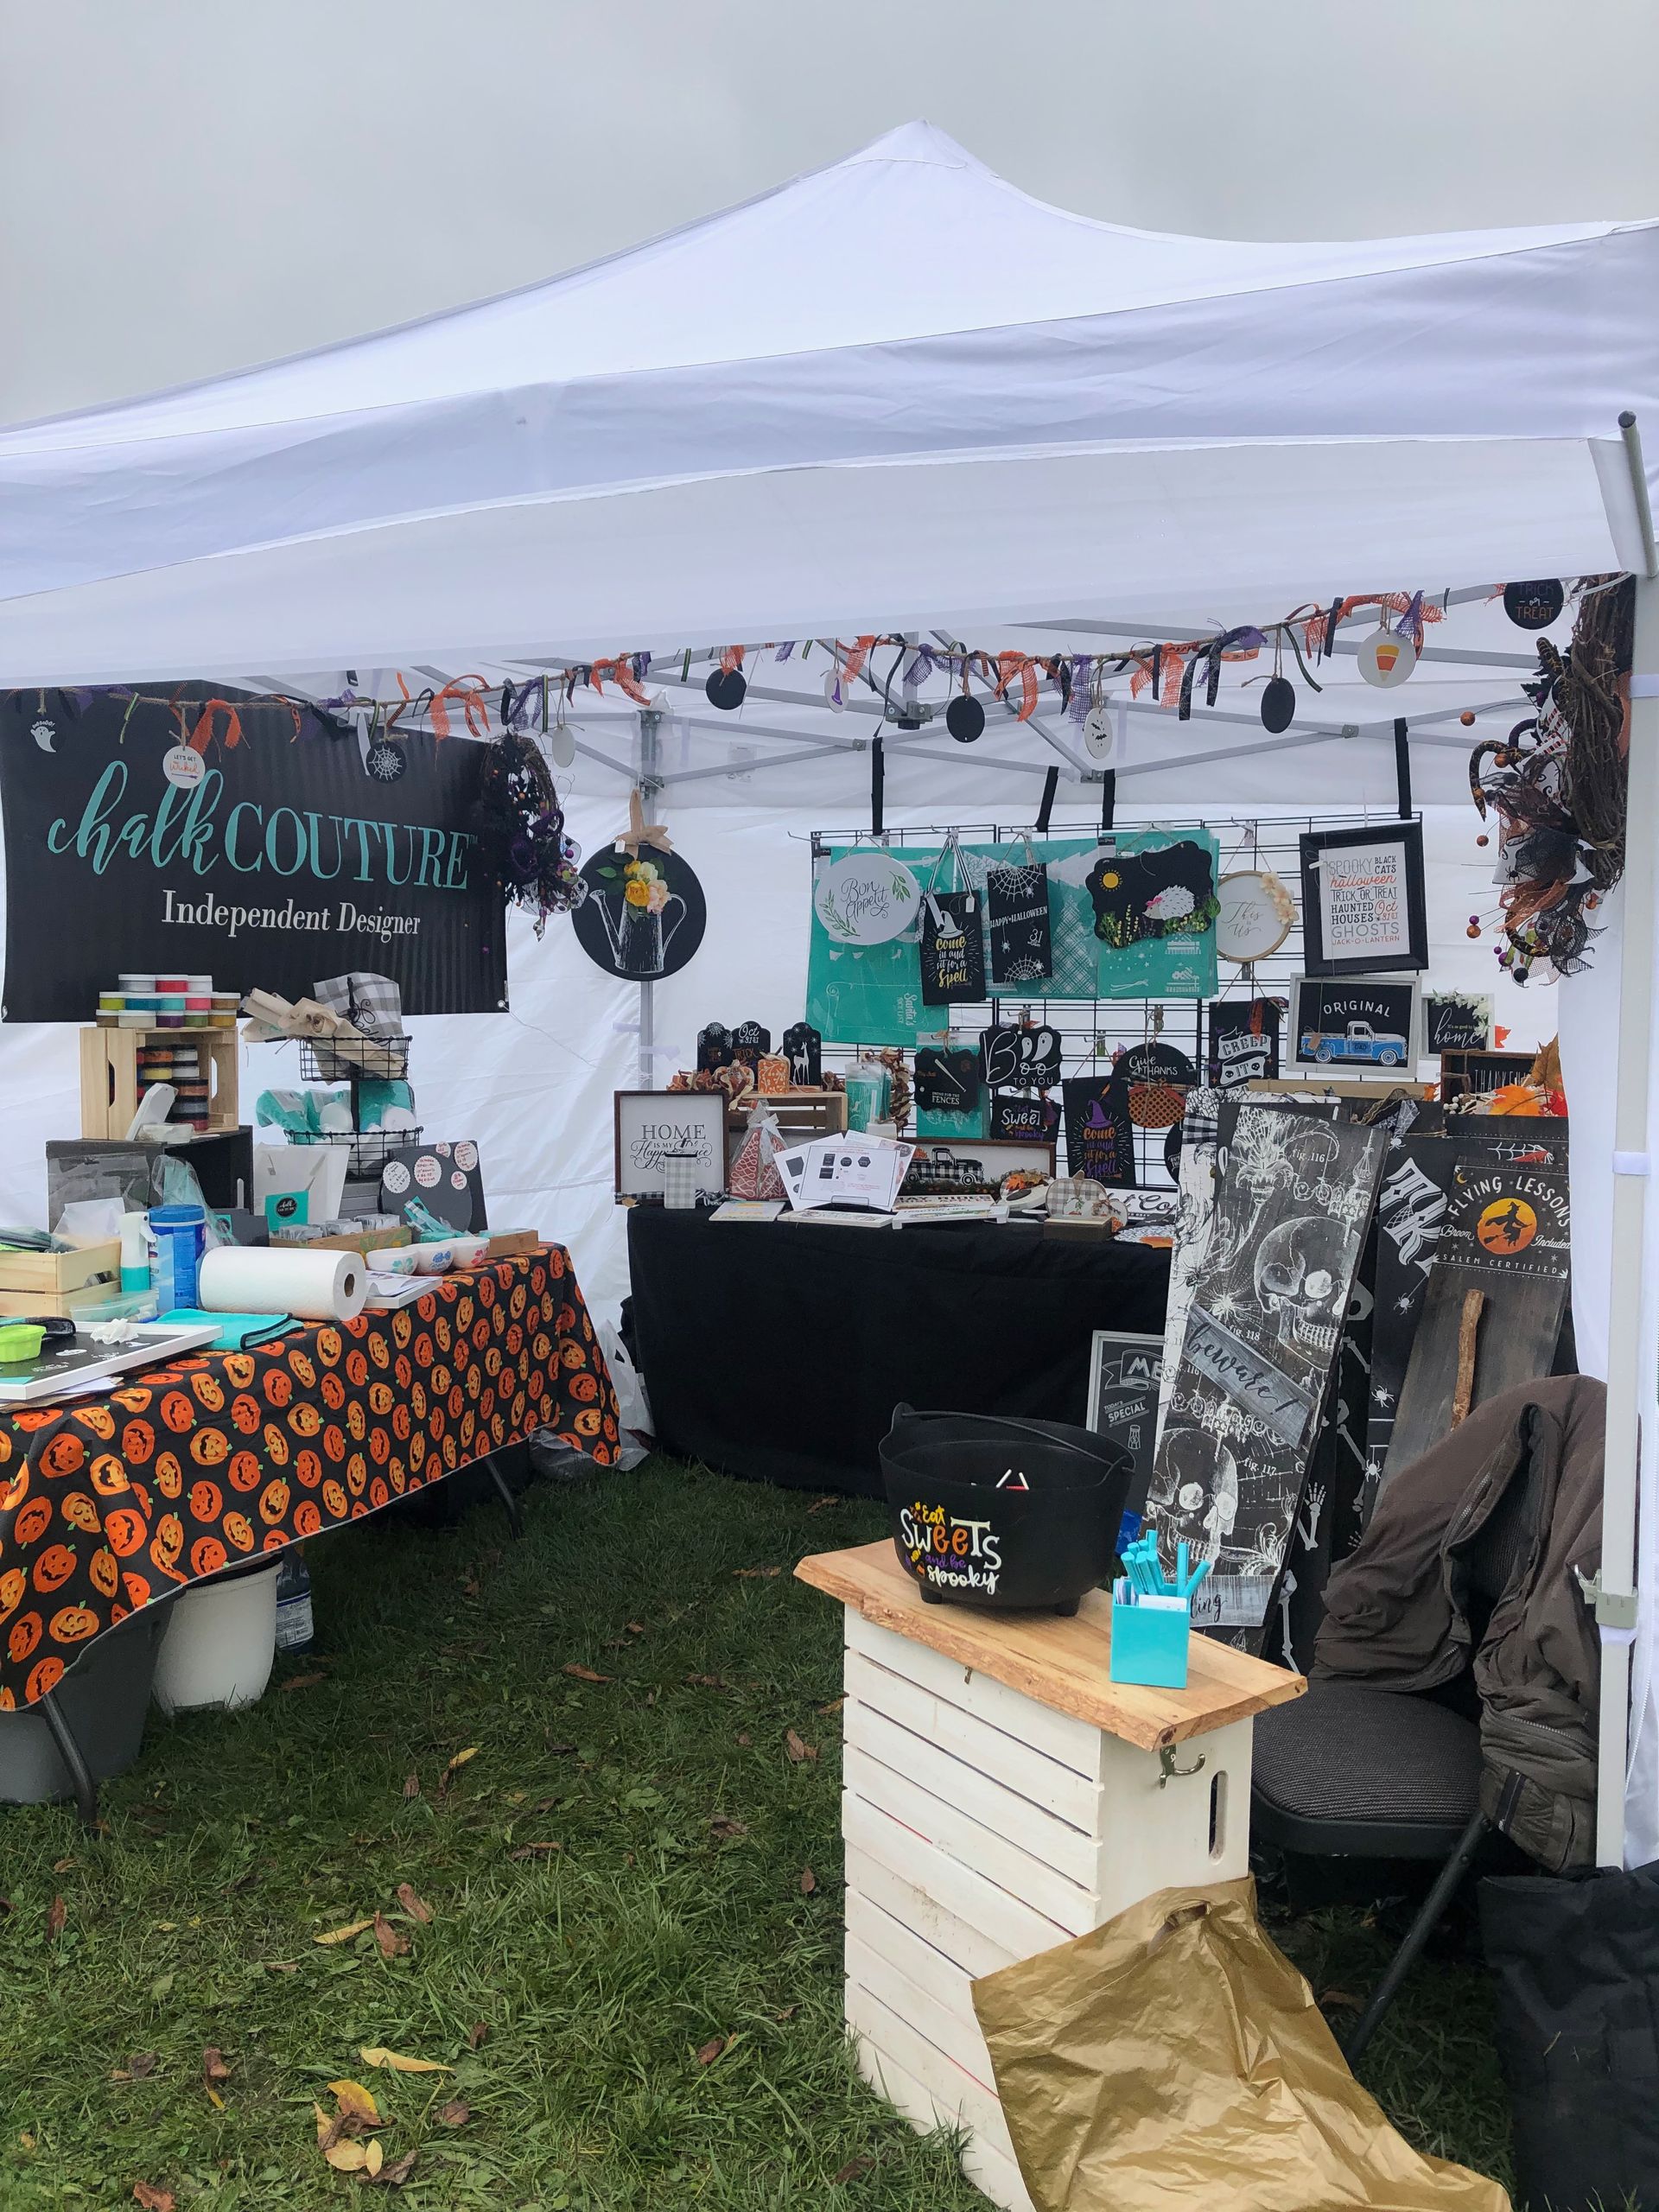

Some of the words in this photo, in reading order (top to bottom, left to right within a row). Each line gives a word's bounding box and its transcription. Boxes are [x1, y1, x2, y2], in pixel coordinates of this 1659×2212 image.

[1515, 606, 1554, 620] TREAT
[48, 760, 225, 875] chalk
[1329, 857, 1373, 876] SPOOKY
[1375, 855, 1396, 864] BLACK
[1375, 864, 1396, 874] CATS
[1331, 874, 1397, 888] halloween
[841, 877, 880, 903] Bon
[1331, 888, 1359, 902] TRICK
[1359, 888, 1374, 900] OR
[1372, 886, 1397, 899] TREAT
[162, 889, 330, 938] Independent
[337, 901, 422, 943] Designer
[1011, 906, 1047, 923] HALLOWEEN
[1332, 902, 1374, 914] HAUNTED
[1375, 899, 1398, 916] Oct
[1332, 913, 1374, 925] HOUSES
[1332, 922, 1399, 938] GHOSTS
[1323, 1000, 1390, 1018] ORIGINAL
[1222, 1035, 1268, 1056] CREEP
[1141, 1065, 1179, 1076] THANKS
[1235, 1063, 1249, 1077] IT
[1014, 1077, 1027, 1085] TO
[1031, 1077, 1053, 1085] YOU
[931, 1096, 960, 1105] FENCES
[641, 1124, 706, 1141] HOME
[630, 1141, 666, 1170] Happ
[1447, 1176, 1502, 1217] FLYING
[1516, 1175, 1571, 1227] LESSONS
[1440, 1224, 1475, 1241] Broom
[1443, 1254, 1480, 1265] SALEM
[1489, 1259, 1557, 1274] CERTIFIED
[1108, 1402, 1146, 1422] SPECIAL
